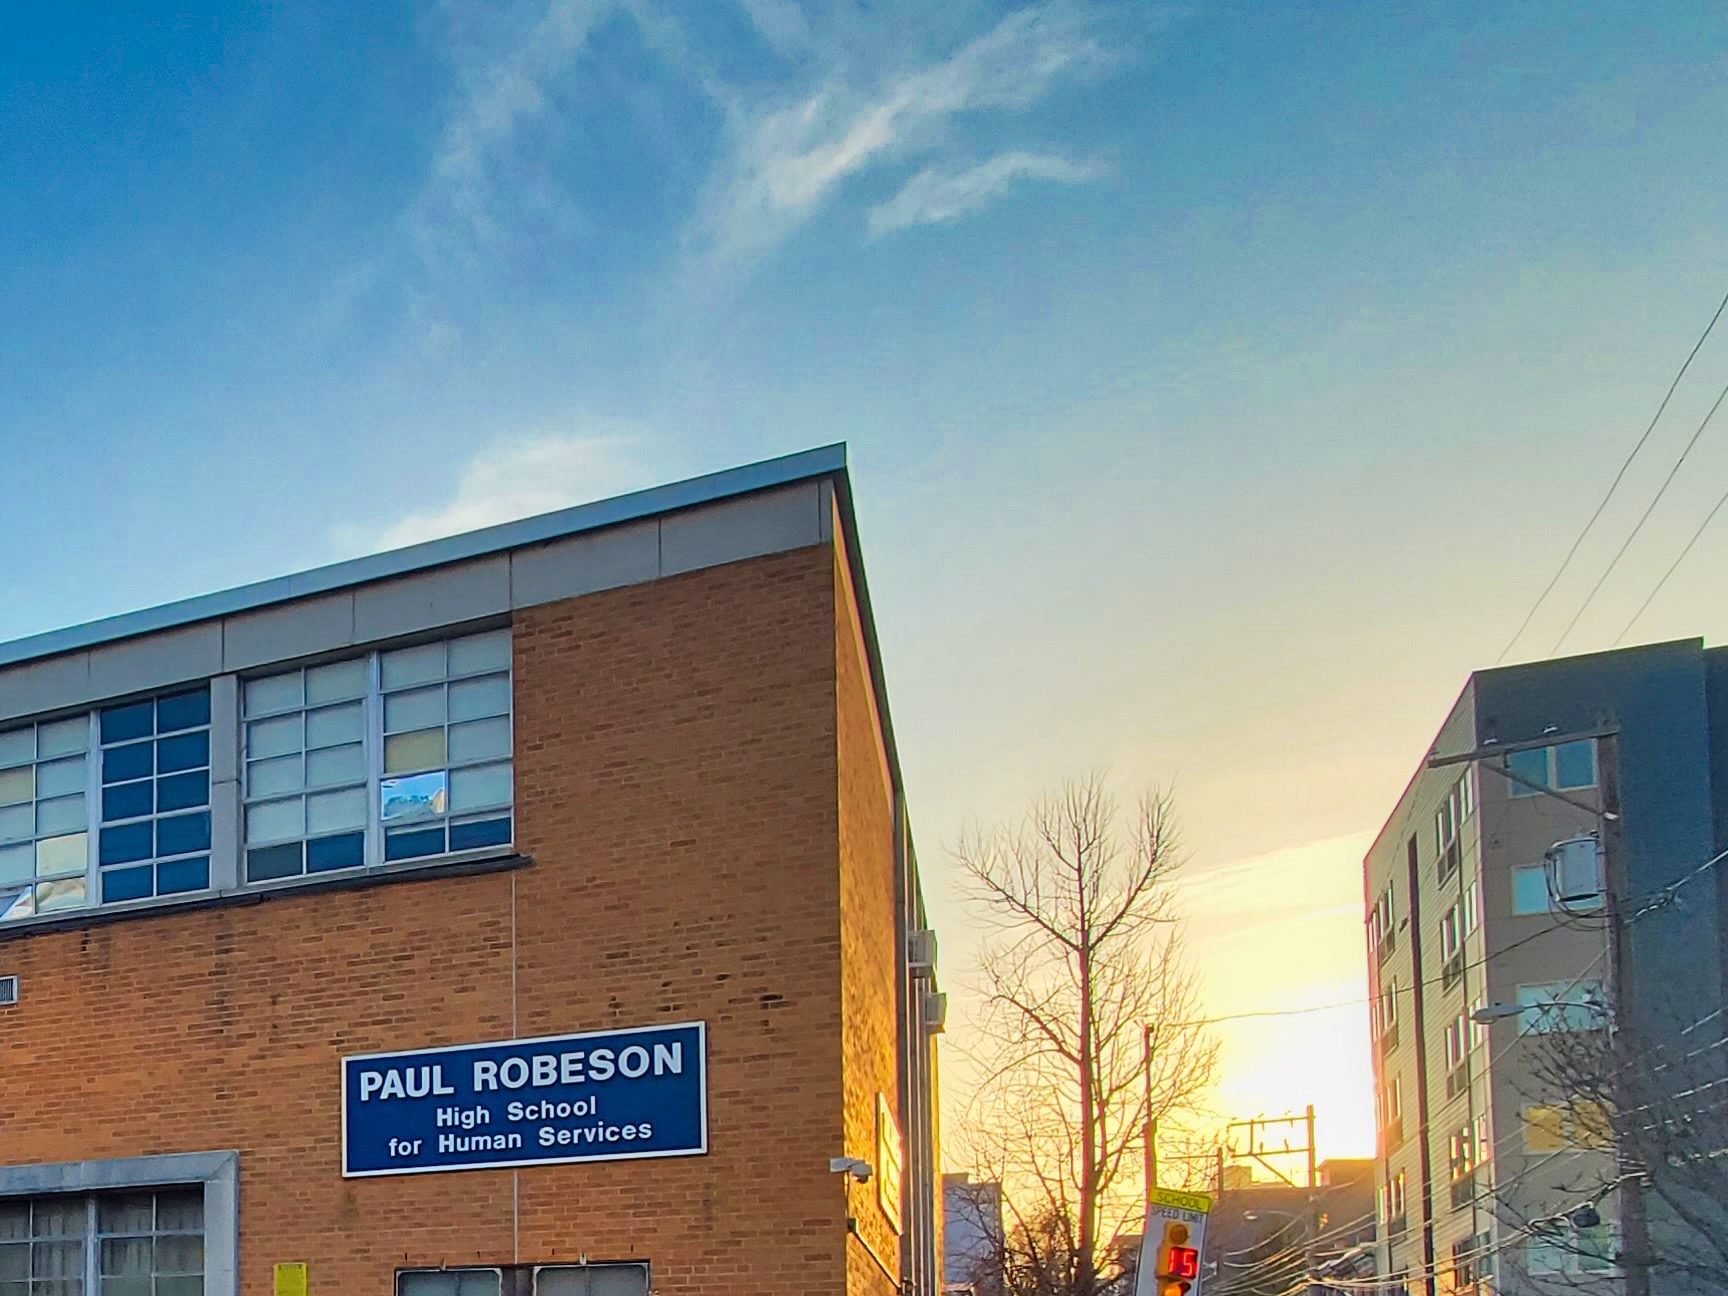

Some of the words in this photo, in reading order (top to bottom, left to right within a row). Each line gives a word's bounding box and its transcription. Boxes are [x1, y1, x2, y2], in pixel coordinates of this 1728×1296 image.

[360, 1065, 455, 1101] PAUL
[473, 1042, 683, 1092] ROBESON
[436, 1105, 490, 1129] High
[507, 1096, 597, 1122] School
[388, 1136, 422, 1157] for
[438, 1131, 522, 1154] Human
[538, 1122, 653, 1148] Services
[1151, 1206, 1179, 1220] SPEED
[1182, 1210, 1205, 1223] LIMIT
[1155, 1191, 1204, 1209] SCHOOL
[1168, 1250, 1197, 1277] 15
